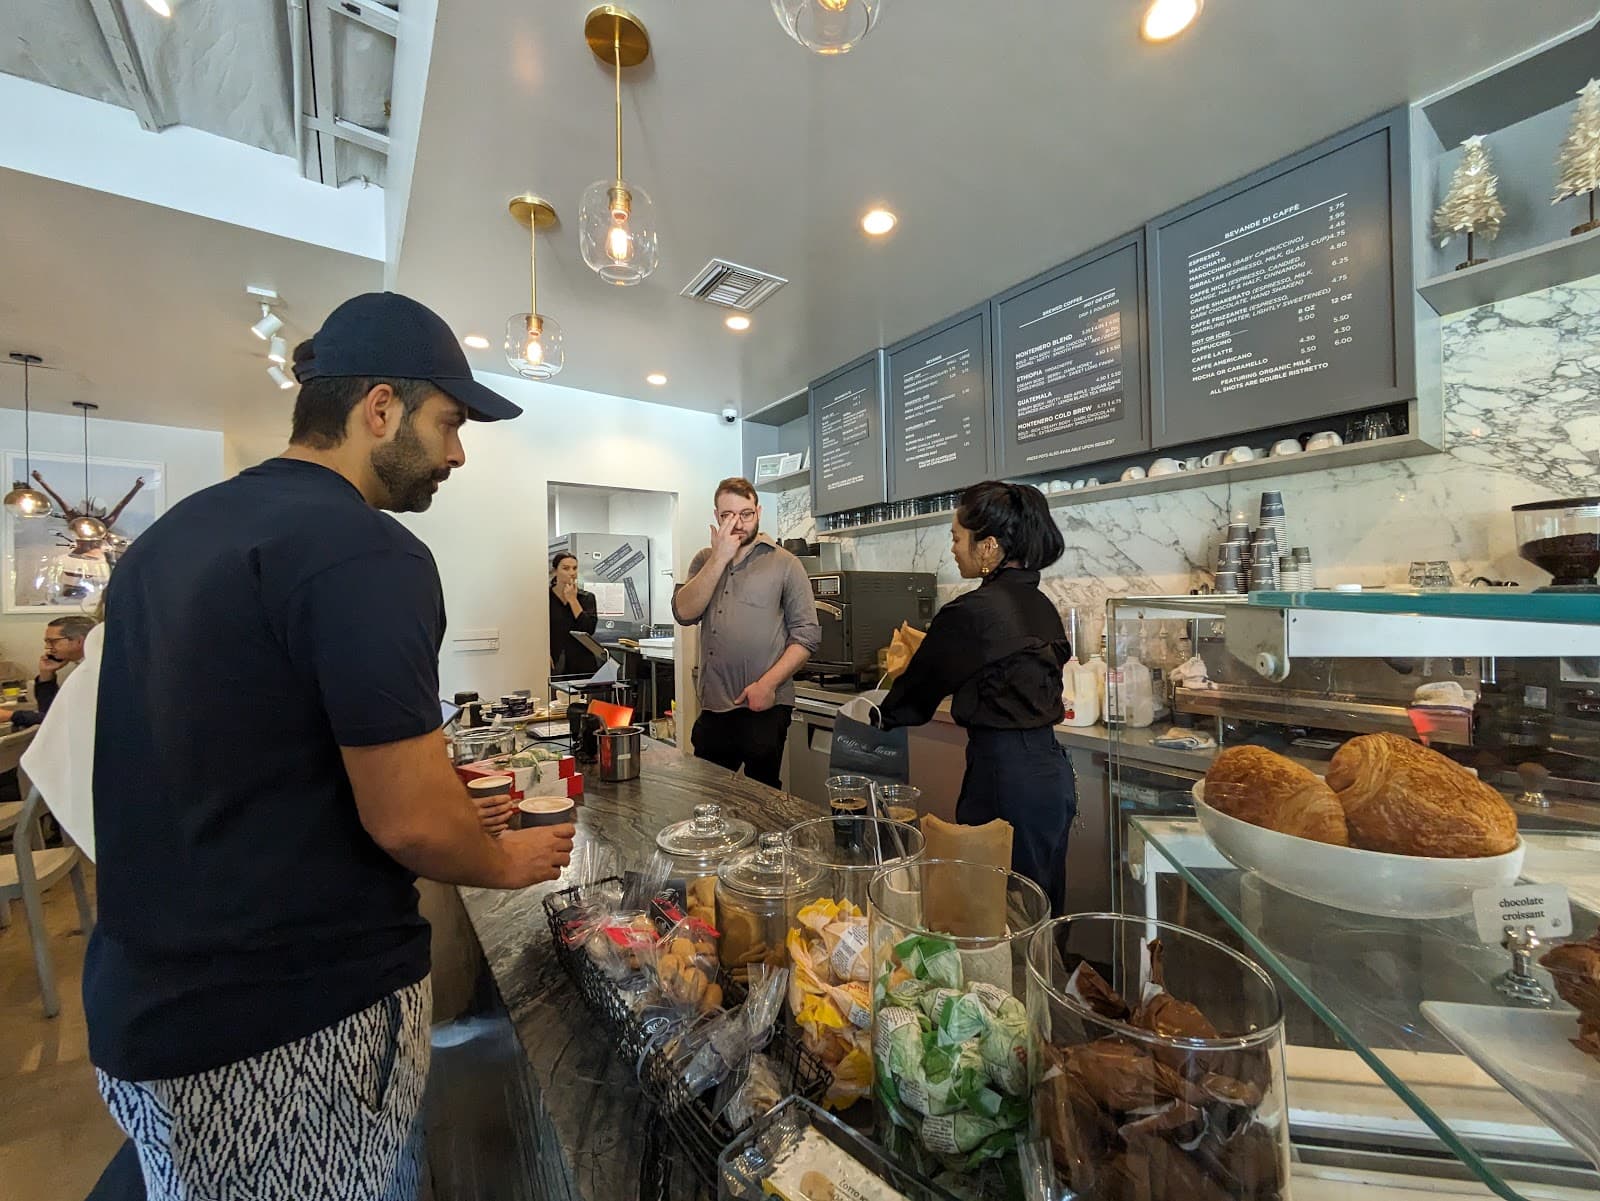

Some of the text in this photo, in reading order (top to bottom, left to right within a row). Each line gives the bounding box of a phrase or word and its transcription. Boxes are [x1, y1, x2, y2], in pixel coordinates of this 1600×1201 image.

[1224, 220, 1260, 238] BEVANDE
[1189, 251, 1220, 266] ESPRESSO
[1189, 263, 1231, 282] MAROCCHINO
[1233, 254, 1253, 266] (BABY
[1255, 236, 1304, 257] CAPPUCCINO)
[1189, 257, 1226, 274] MACCHIATO
[1190, 274, 1224, 289] GIBRALTAR
[1286, 242, 1309, 255] GLASS
[1311, 235, 1329, 245] CUP)
[1211, 283, 1226, 292] NICO
[1268, 257, 1300, 271] CANDIED
[1219, 286, 1235, 295] HALF
[1264, 262, 1305, 279] CINNAMON)
[1191, 311, 1207, 320] DARK
[1251, 291, 1270, 300] HAND
[1272, 279, 1304, 293] SHAKEN)
[1212, 291, 1250, 307] SHAKERATO
[1191, 321, 1224, 335] SPARKLING
[1252, 303, 1281, 316] LIGHTLY
[1282, 288, 1331, 307] SWEETENED)
[1212, 308, 1247, 322] FRIZZANTE
[1016, 334, 1072, 359] MONTENERO BLEND
[1192, 338, 1232, 353] CAPPUCCINO
[1213, 348, 1233, 357] LATTE
[1213, 352, 1252, 367] AMERICANO
[1016, 370, 1043, 382] ETHIOPIA
[1192, 372, 1215, 381] MOCHA
[1227, 359, 1268, 372] CARAMELLO
[1221, 358, 1311, 385] FEATURING ORGANIC MILK
[1223, 383, 1243, 392] SHOTS
[1259, 372, 1287, 383] DOUBLE
[1289, 362, 1328, 376] RISTRETTO
[1018, 391, 1052, 406] GUATEMALA
[1018, 416, 1053, 430] MONTENERO
[1055, 411, 1071, 420] COLD
[1073, 405, 1092, 416] BREW
[1499, 897, 1544, 908] chocolate
[1502, 910, 1544, 920] croissant
